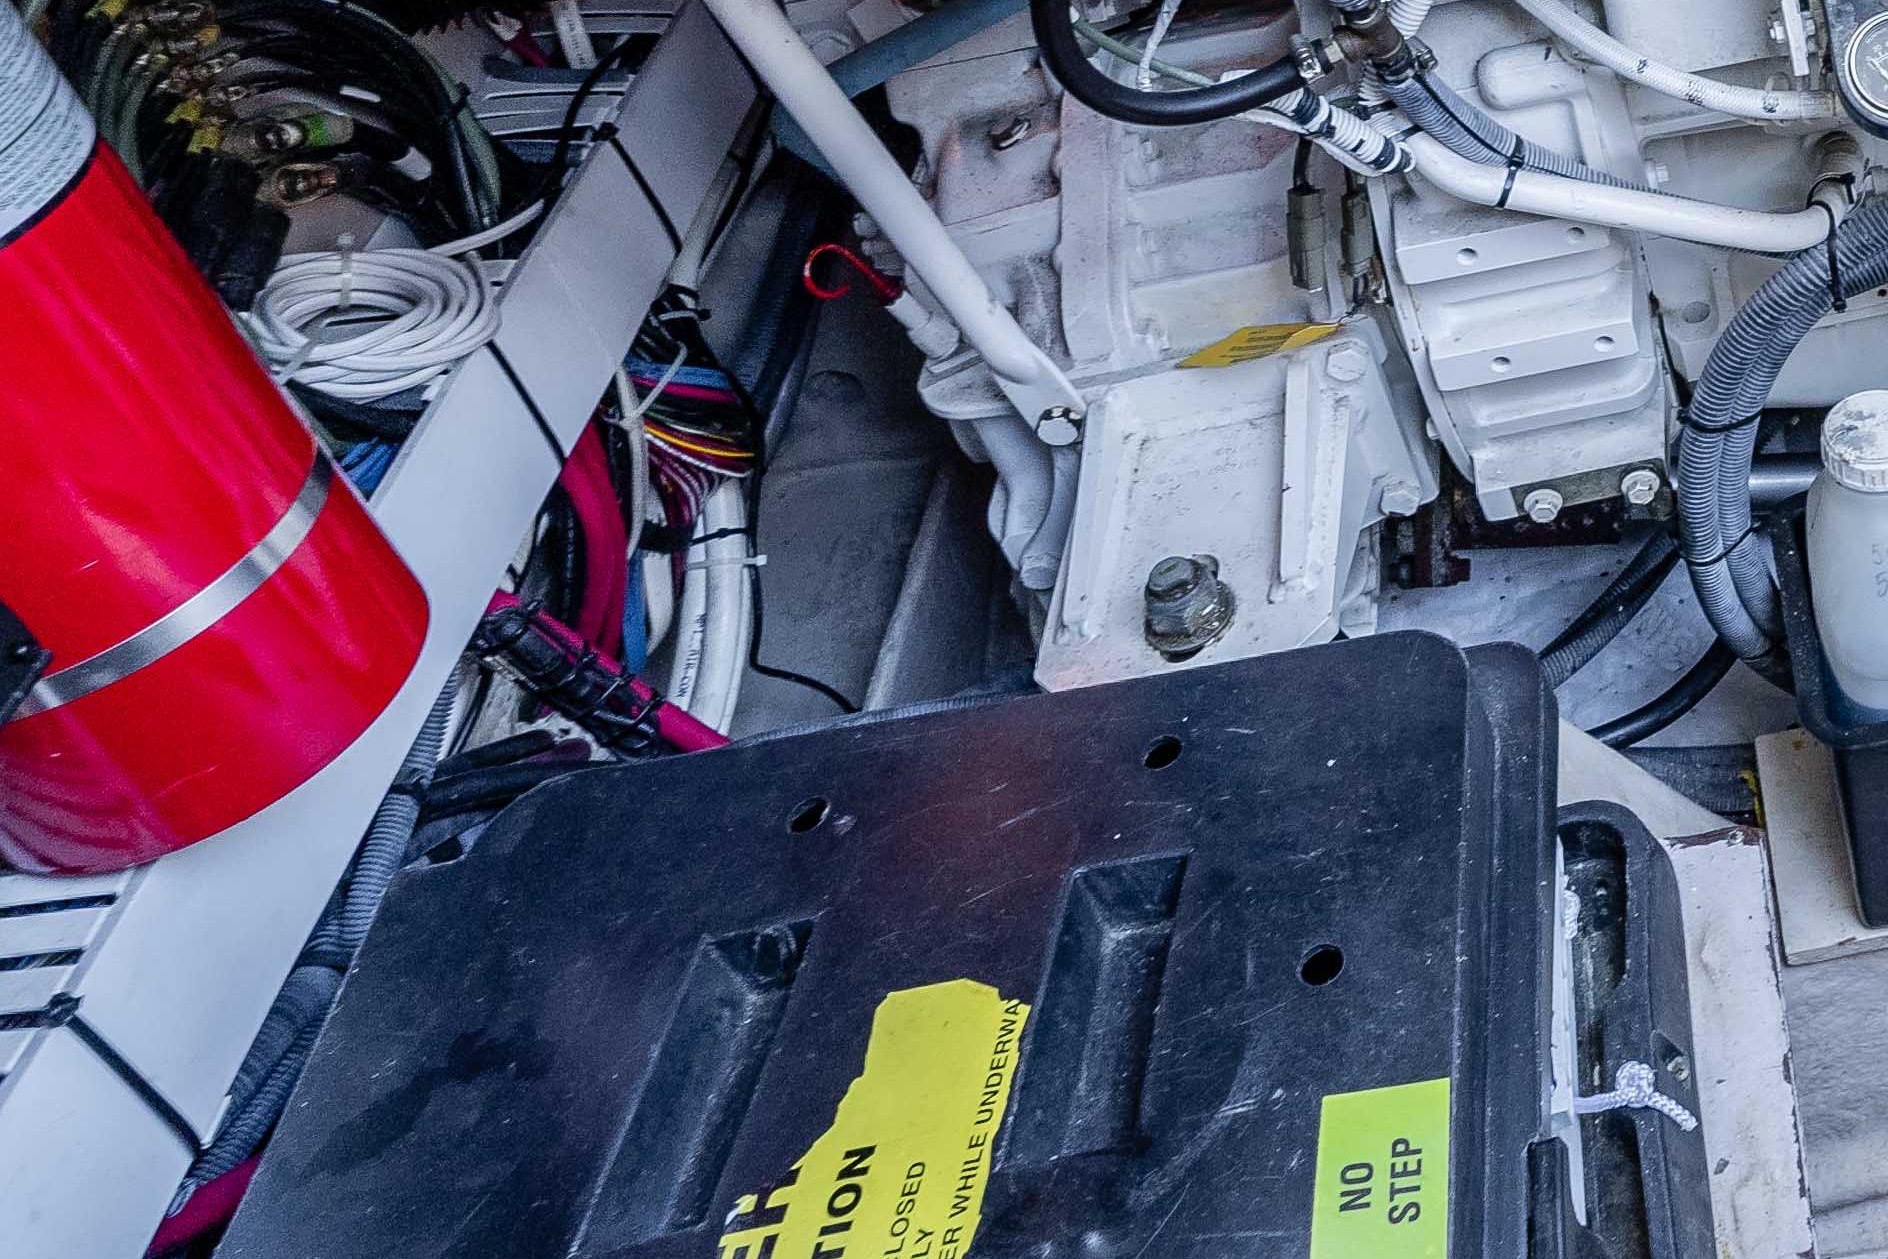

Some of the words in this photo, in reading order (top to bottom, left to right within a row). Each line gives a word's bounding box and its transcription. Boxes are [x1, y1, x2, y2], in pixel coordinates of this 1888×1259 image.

[884, 1160, 926, 1259] LOSED
[949, 1131, 989, 1217] WHILE
[1338, 1161, 1375, 1213] NO
[1387, 1137, 1423, 1225] STEP
